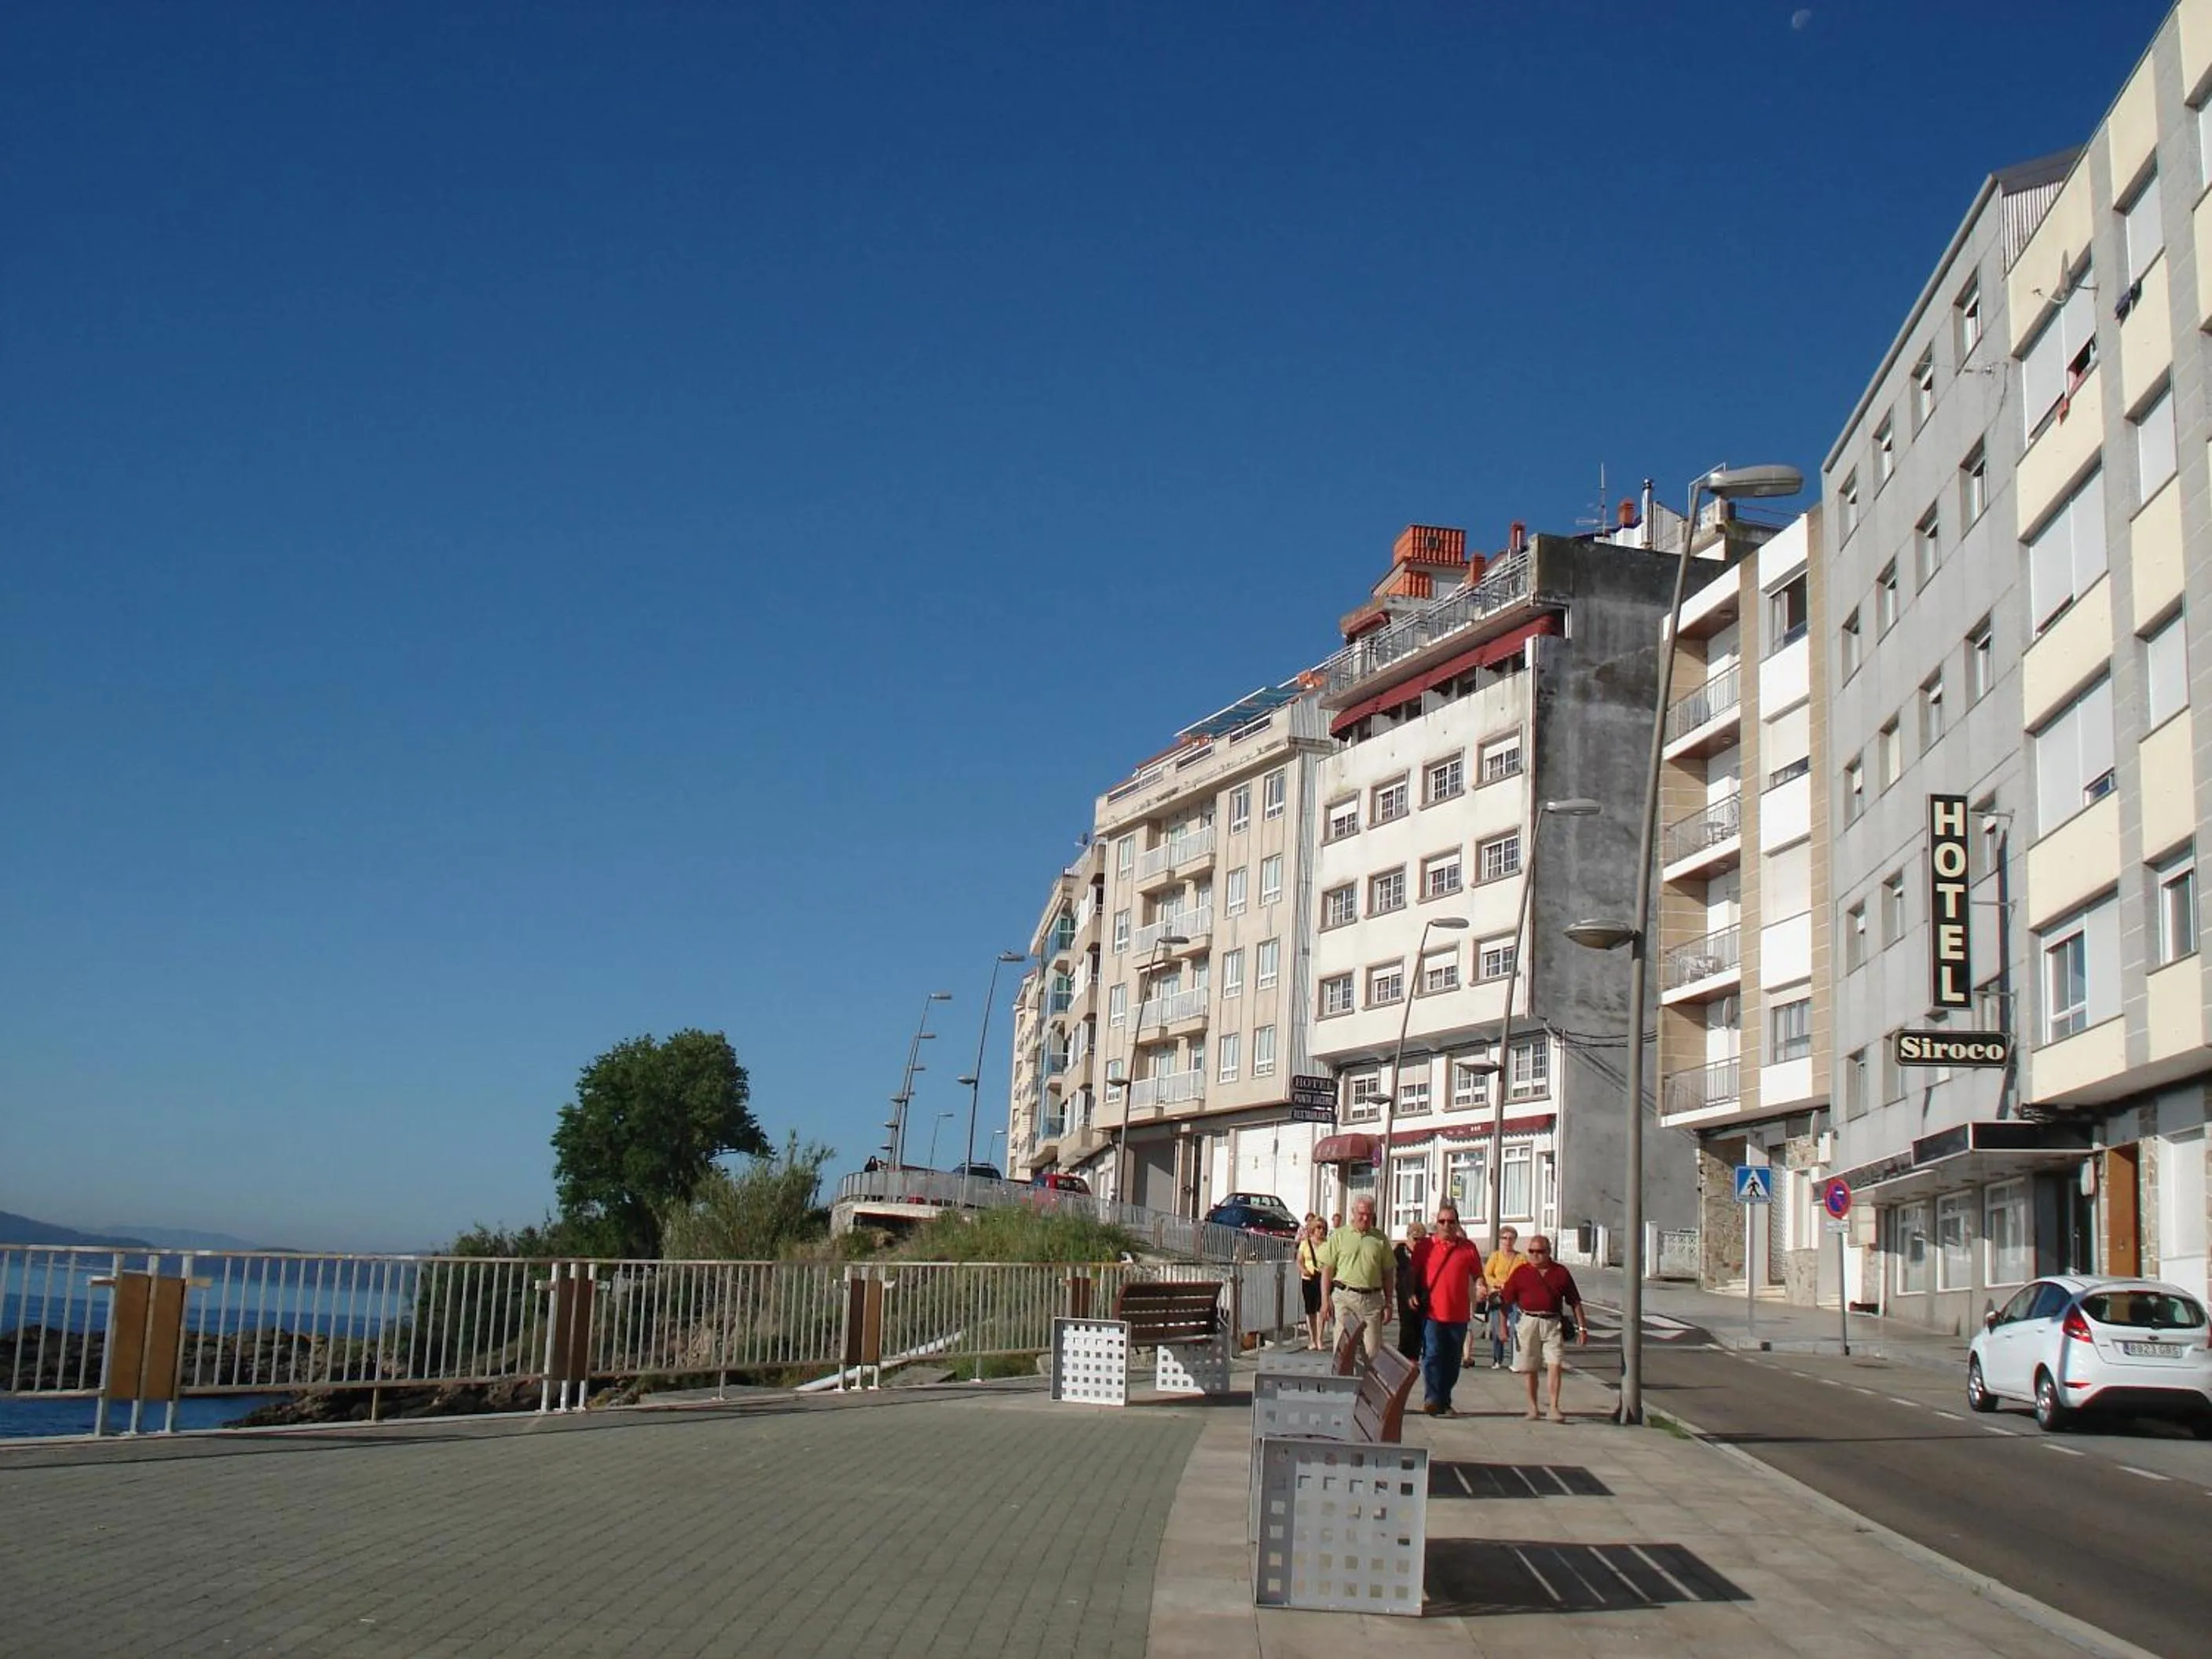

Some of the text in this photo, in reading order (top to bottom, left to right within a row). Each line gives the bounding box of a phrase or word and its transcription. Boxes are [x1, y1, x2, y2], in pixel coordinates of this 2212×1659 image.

[1933, 800, 1967, 1002] HOTEL
[1900, 1036, 2005, 1060] Siroco
[1295, 1077, 1334, 1090] HOTEL
